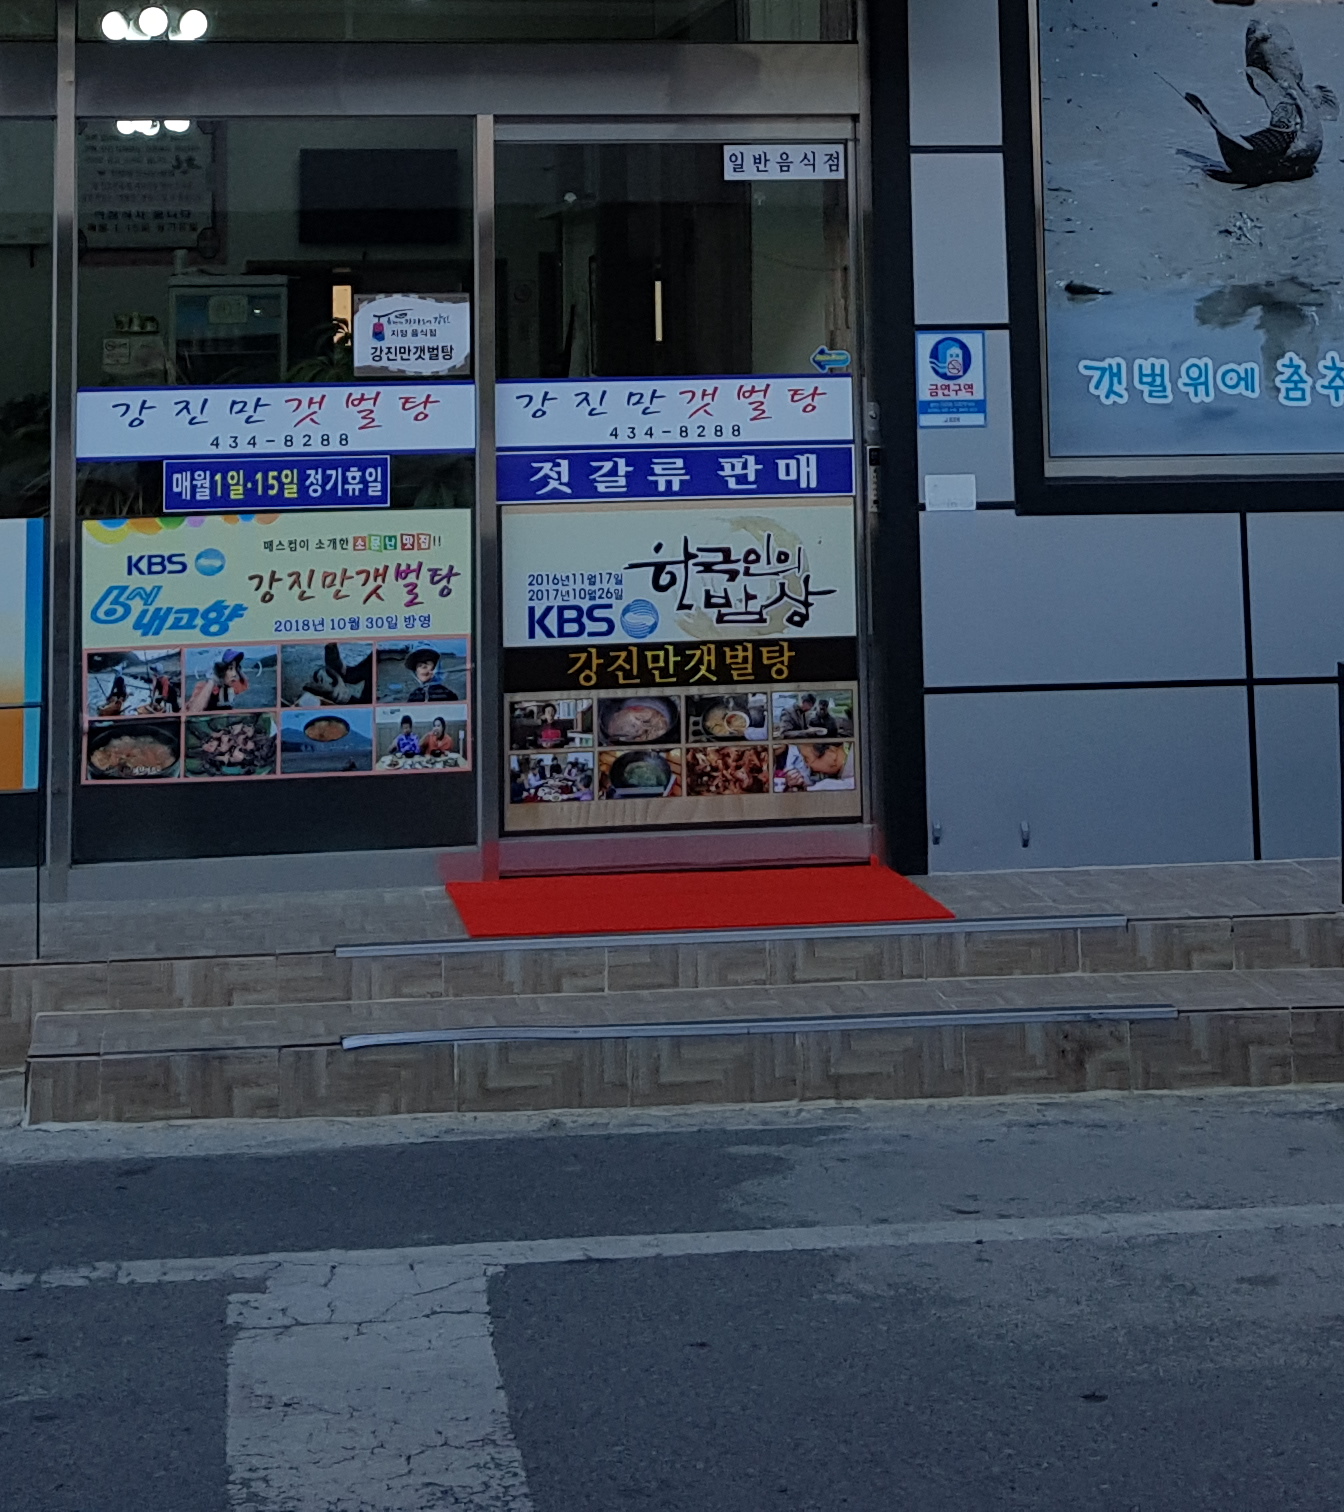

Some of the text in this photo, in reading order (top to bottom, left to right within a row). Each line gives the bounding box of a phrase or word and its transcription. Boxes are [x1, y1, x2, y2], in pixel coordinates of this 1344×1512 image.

[728, 150, 841, 175] 일반음식점
[370, 345, 455, 362] 강진만갯벌탕
[515, 383, 828, 422] 강진만갯벌탕
[928, 382, 974, 398] 금연구역
[111, 390, 441, 430] 강진만갯벌탕
[209, 432, 351, 449] 434-8288
[609, 424, 742, 439] 434-8288
[304, 466, 383, 498] 정기휴일
[529, 453, 819, 495] 젓갈류 판매
[314, 536, 349, 551] 소개한
[126, 553, 188, 576] KBS
[247, 561, 461, 608] 강진만갯벌탕
[90, 585, 164, 625] 6시
[131, 598, 248, 638] 내고향
[527, 603, 616, 639] KBS
[274, 613, 432, 633] 2018년 10월 30일 방영
[567, 641, 796, 687] 강진만갯벌탕
